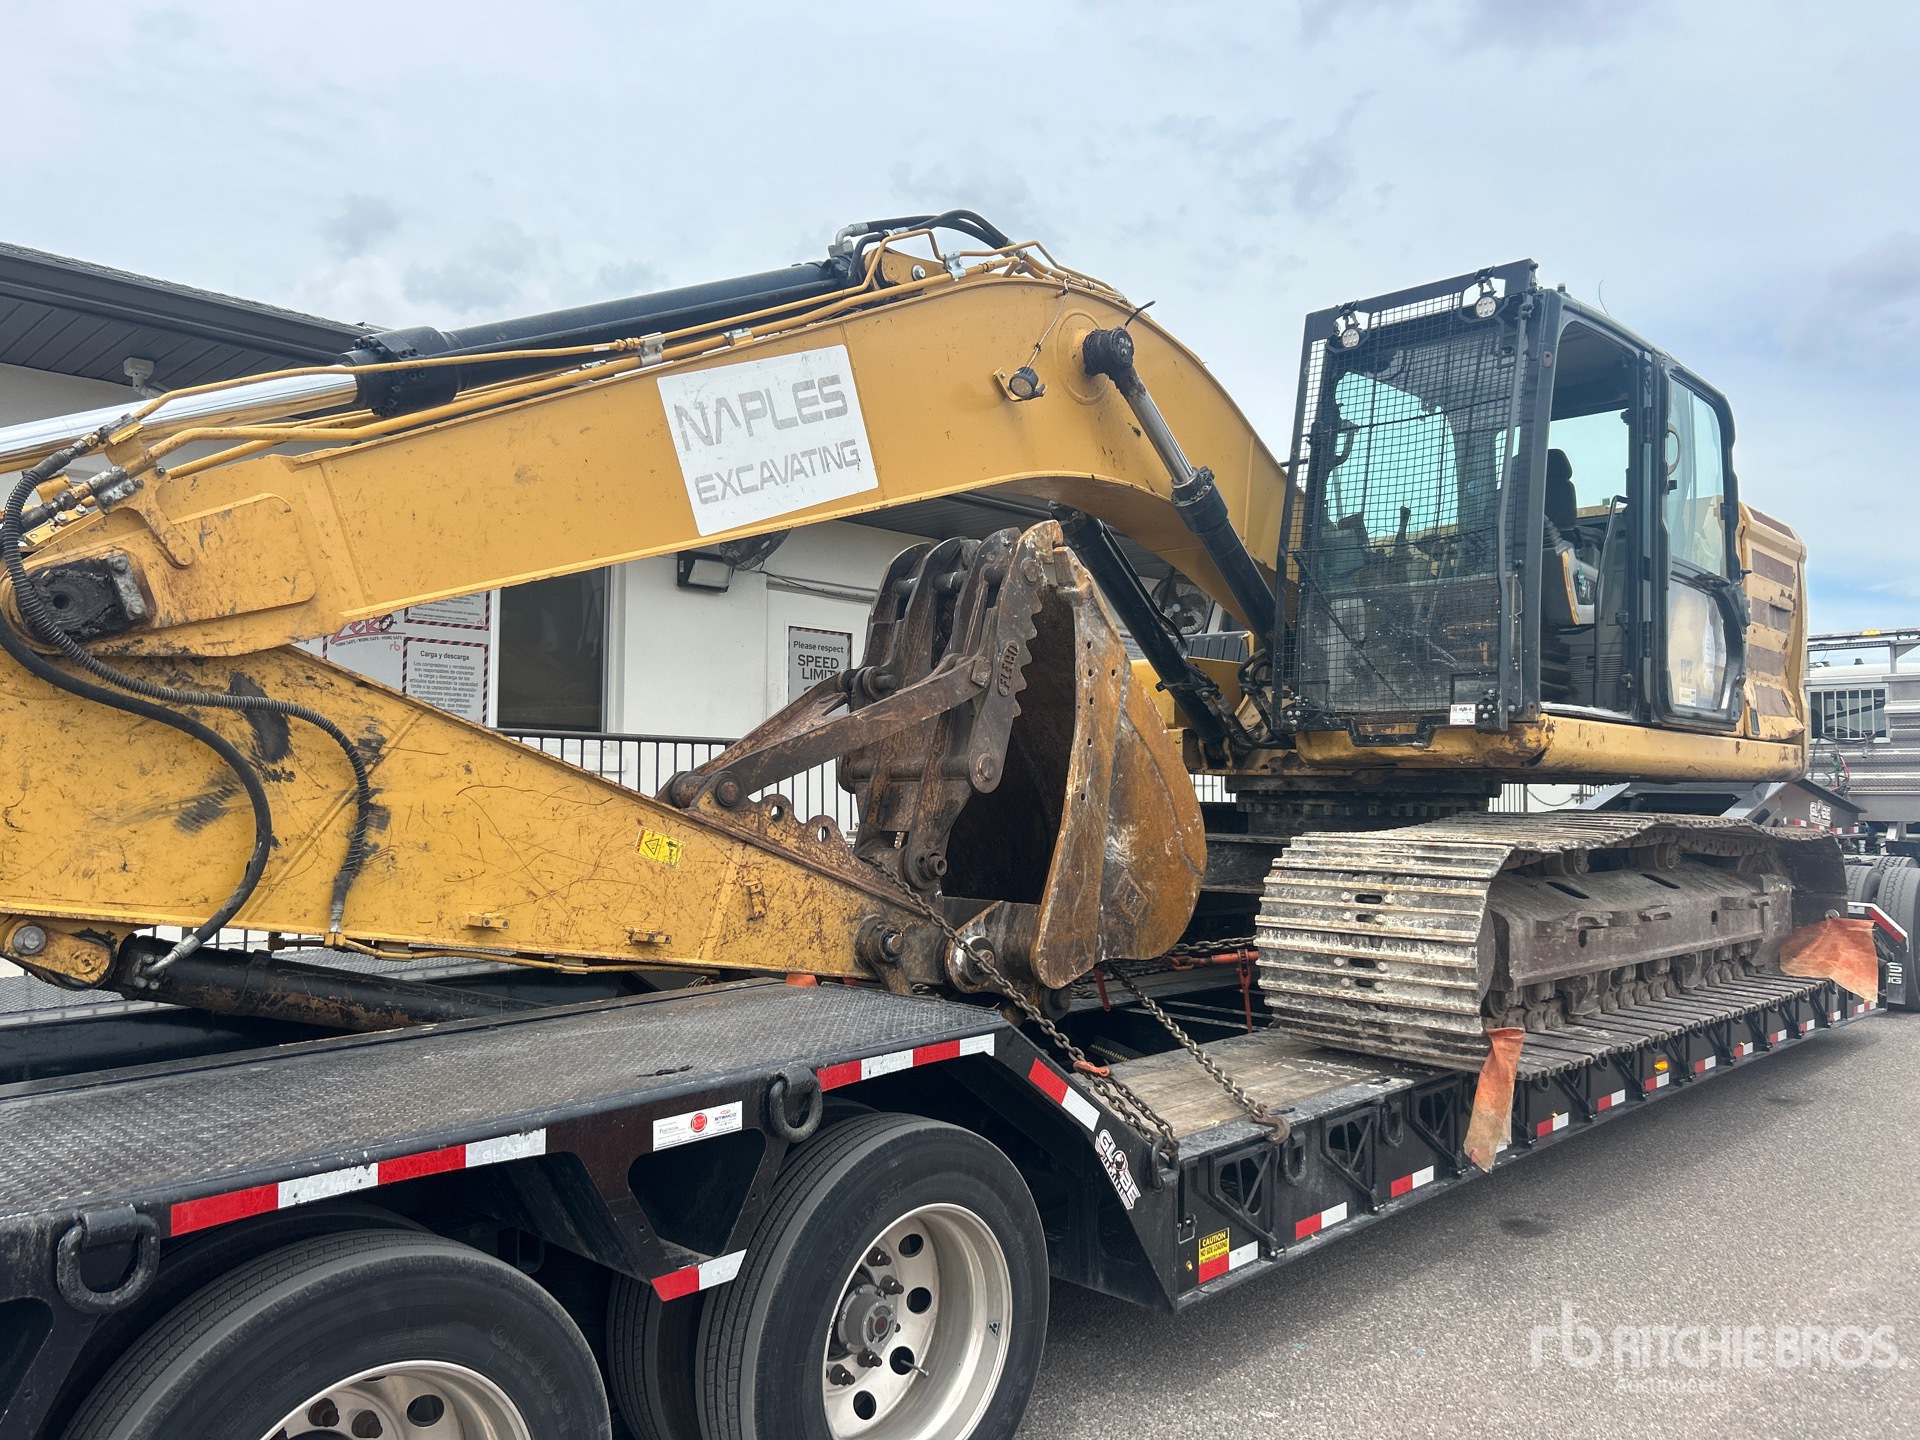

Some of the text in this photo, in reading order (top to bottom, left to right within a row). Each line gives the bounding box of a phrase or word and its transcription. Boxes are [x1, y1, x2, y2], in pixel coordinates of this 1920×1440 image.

[674, 374, 848, 452] NAPLES
[694, 439, 861, 505] EXCAVATING
[793, 640, 845, 654] Please respect
[420, 650, 437, 659] Carga
[443, 652, 470, 662] descarga
[797, 654, 839, 670] SPEED
[1202, 1230, 1226, 1247] CAUTION
